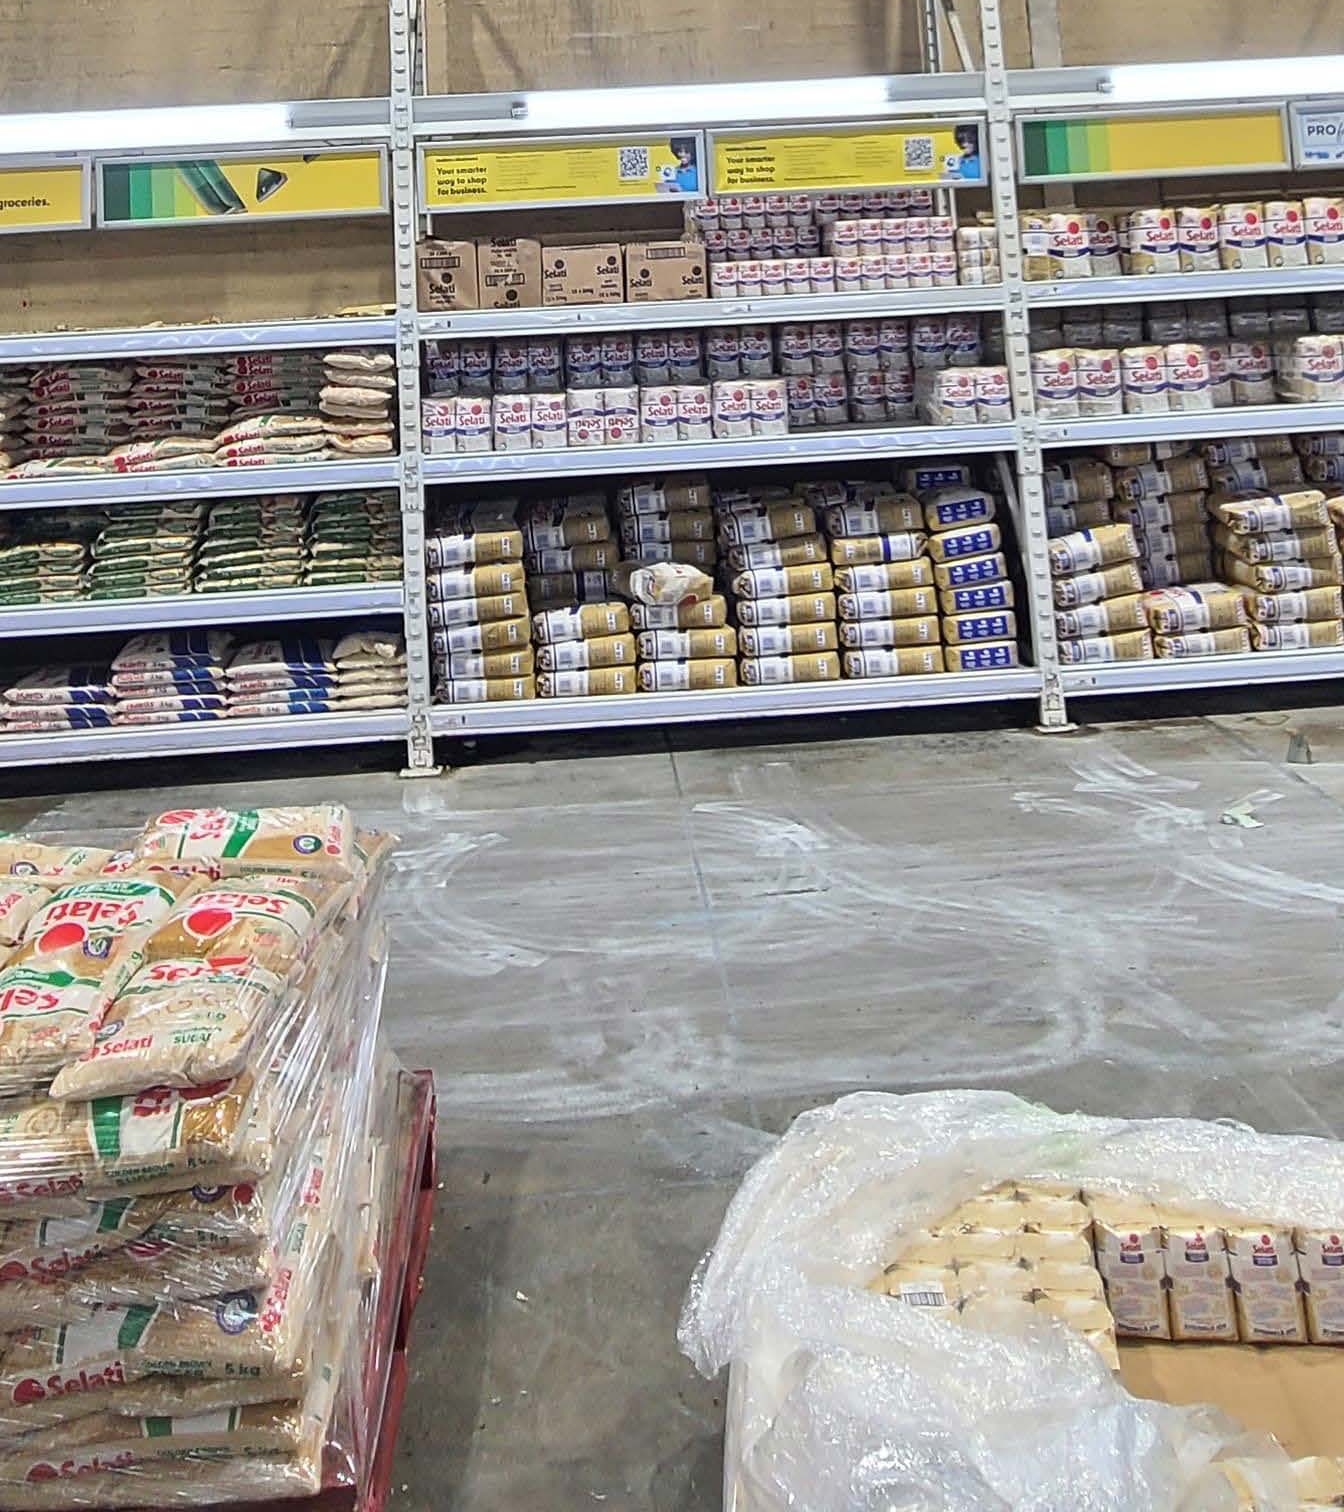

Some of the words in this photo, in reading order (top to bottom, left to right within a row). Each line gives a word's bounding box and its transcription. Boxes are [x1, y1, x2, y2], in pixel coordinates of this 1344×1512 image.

[727, 157, 743, 165] Your
[745, 155, 775, 163] smarter
[436, 166, 455, 176] Your
[456, 166, 487, 175] smarter
[727, 167, 744, 176] way
[746, 165, 755, 173] to
[756, 165, 775, 175] shop
[437, 178, 455, 187] way
[456, 176, 465, 185] to
[467, 176, 487, 186] shop
[727, 176, 738, 185] for
[437, 187, 449, 196] for
[544, 269, 568, 280] Selati
[597, 265, 620, 276] Selati
[630, 278, 653, 288] Selati
[682, 275, 705, 286] Selati
[429, 283, 457, 295] Selati
[46, 898, 145, 927] Selati
[100, 1033, 154, 1060] Selati
[225, 1363, 234, 1378] 5
[236, 1362, 262, 1378] kg
[47, 1360, 127, 1396] Selati
